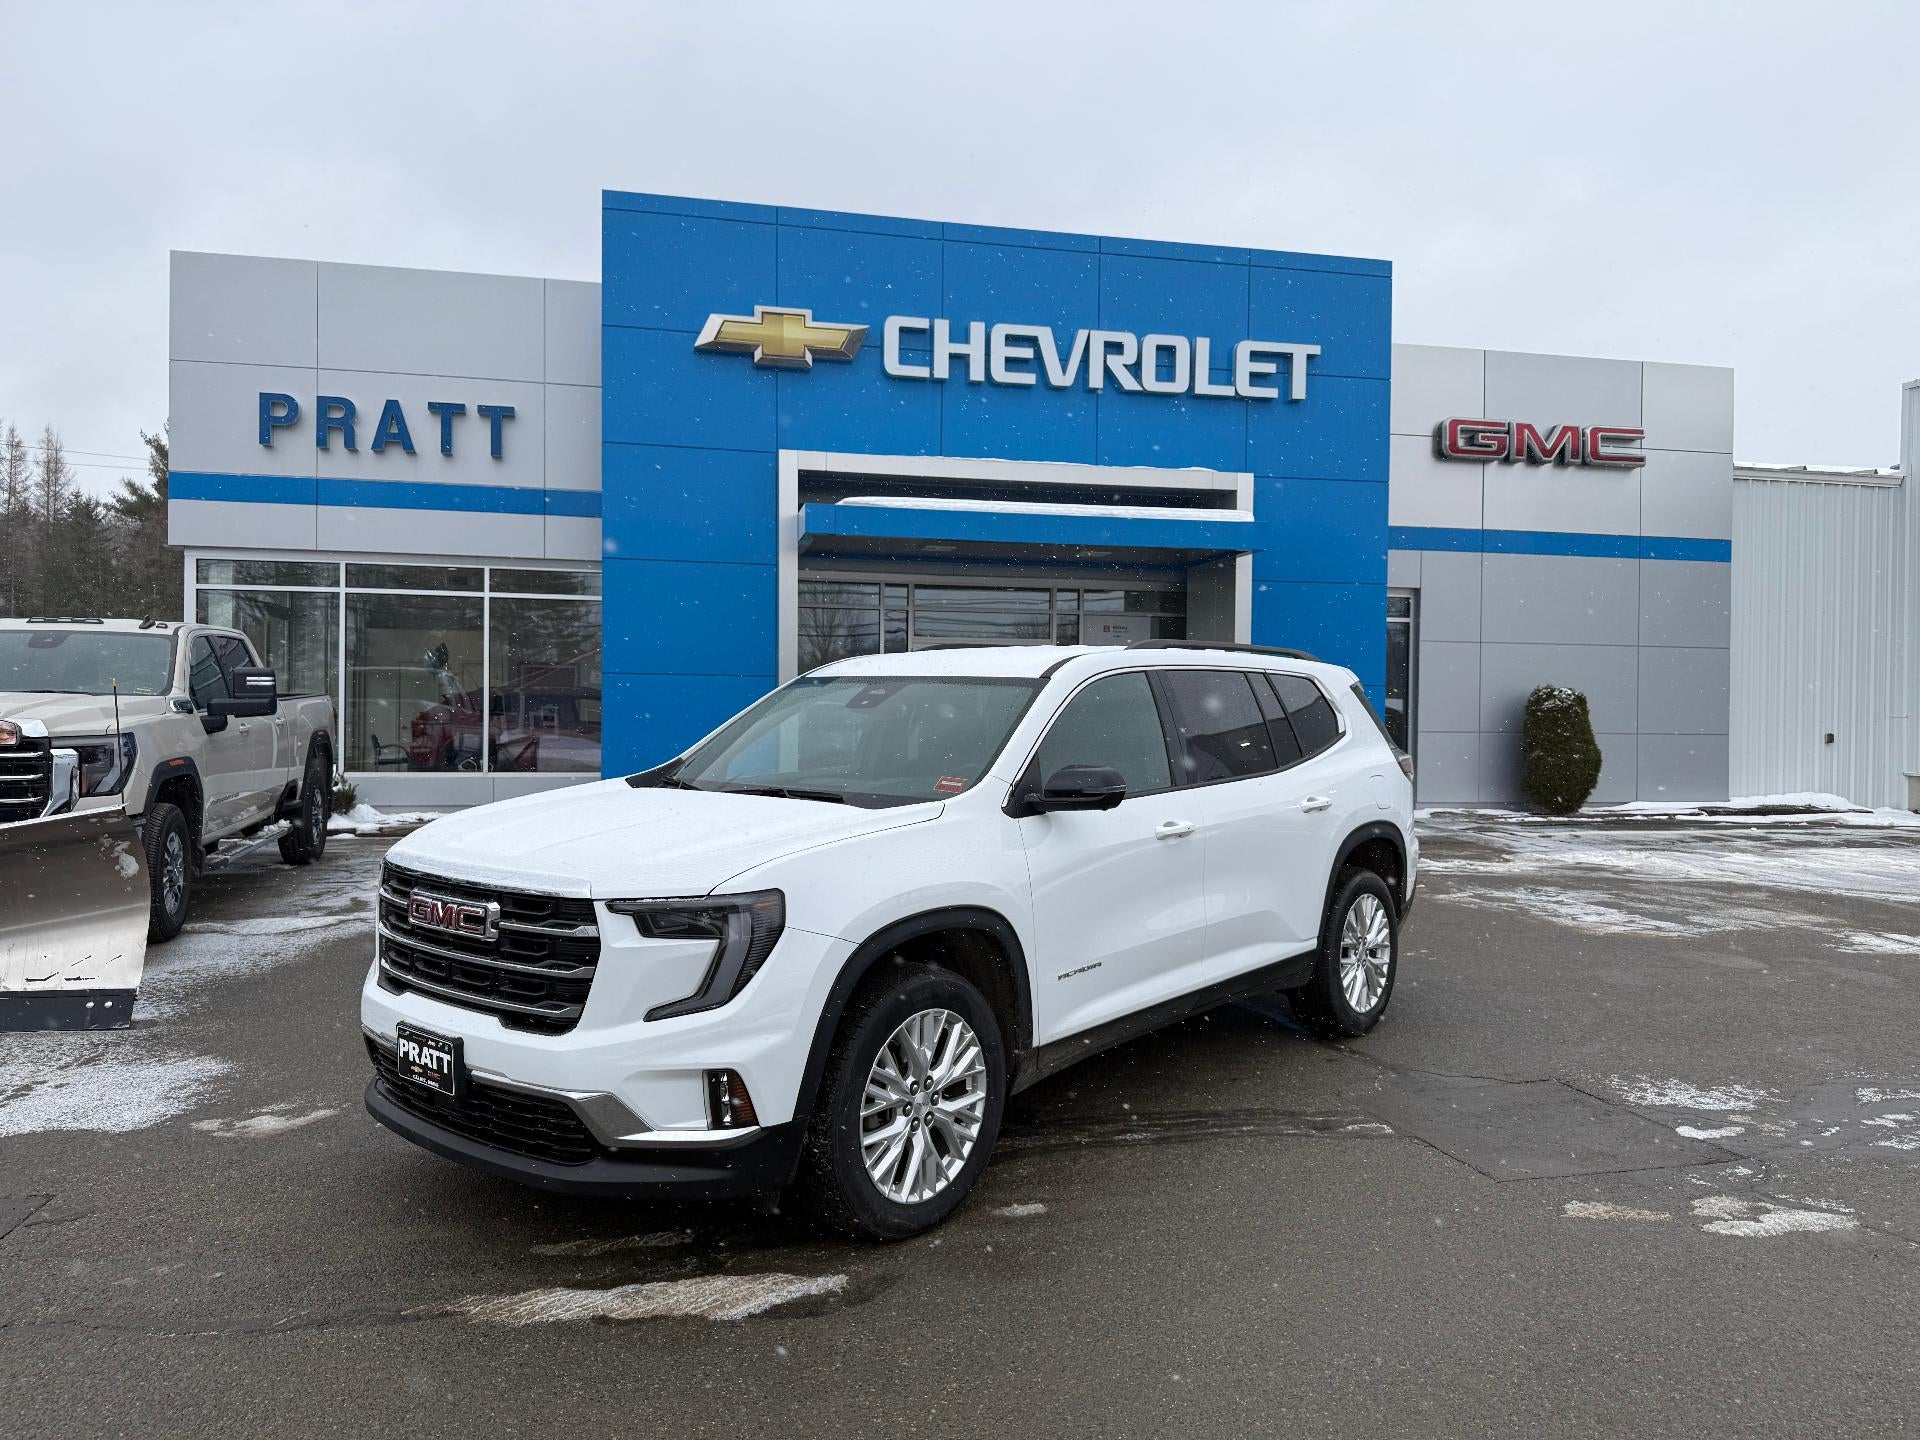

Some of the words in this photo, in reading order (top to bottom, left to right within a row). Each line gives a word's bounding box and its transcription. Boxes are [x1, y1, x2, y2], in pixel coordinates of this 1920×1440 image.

[884, 315, 1321, 400] CHEVROLET
[259, 392, 515, 458] PRATT
[1436, 417, 1646, 468] GMC
[411, 896, 484, 933] GMC
[400, 1038, 451, 1074] PRATT
